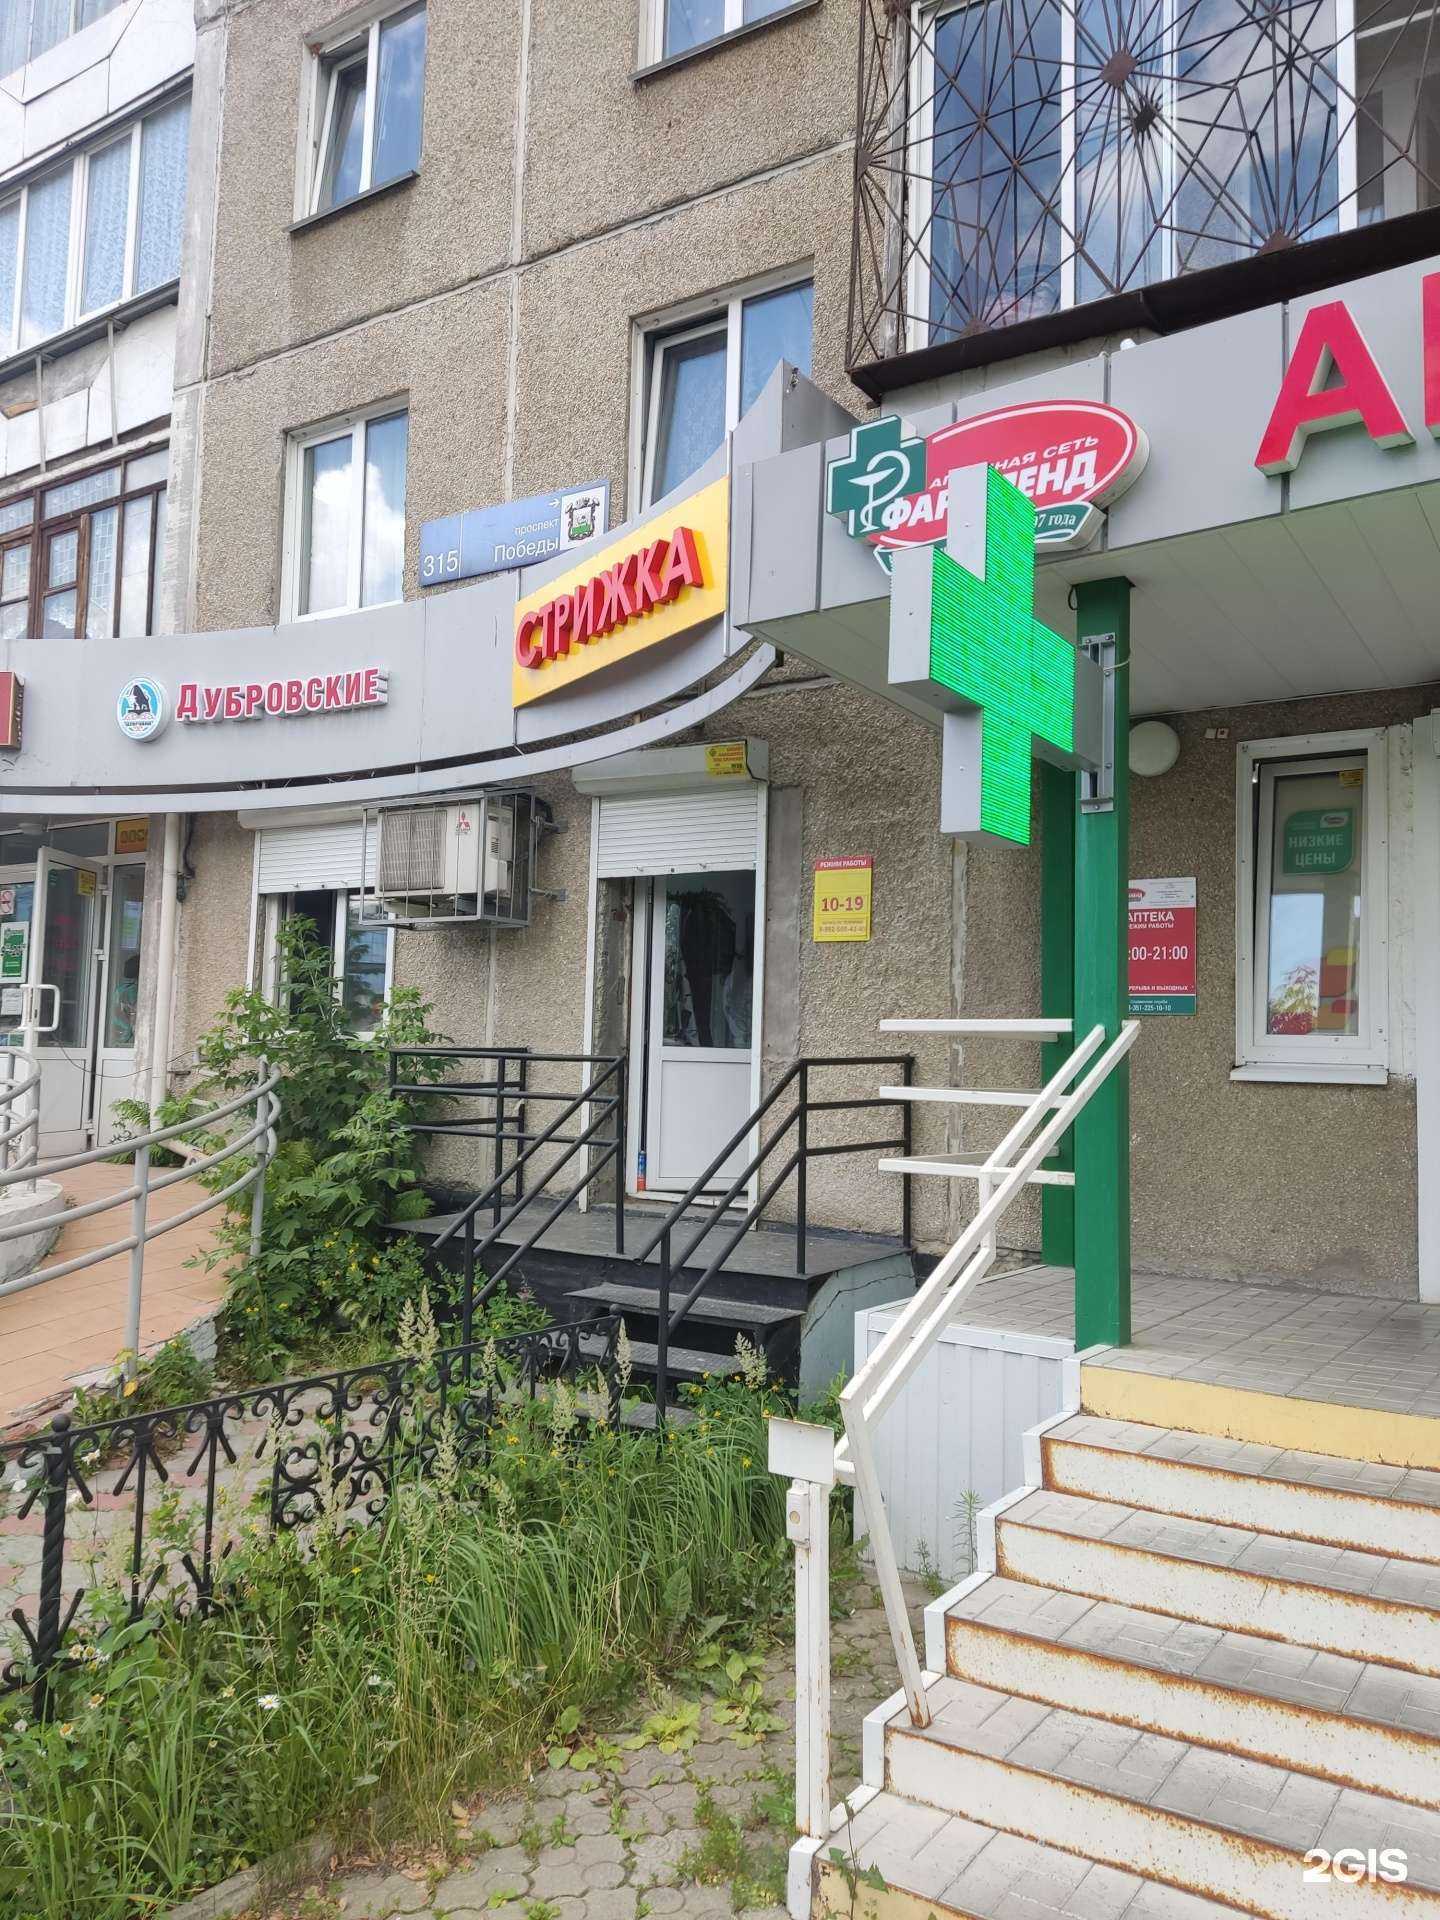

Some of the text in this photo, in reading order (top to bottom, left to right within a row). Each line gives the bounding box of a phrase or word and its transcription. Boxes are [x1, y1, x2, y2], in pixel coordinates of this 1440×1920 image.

[1254, 271, 1440, 476] А
[928, 436, 1099, 490] АПНАЯ СЕТЬ
[881, 450, 1098, 531] ФАРЕНД
[514, 518, 560, 537] проспект
[1048, 513, 1077, 527] года
[494, 537, 560, 562] Победы
[423, 550, 459, 577] 315
[516, 526, 704, 669] СТРИЖКА
[176, 667, 389, 723] ДУБРОВСКИЕ
[1289, 833, 1345, 848] НИЗКИЕ
[842, 859, 867, 868] РАБОТЫ
[1295, 851, 1336, 867] ЦЕНЫ
[821, 896, 864, 912] 10-19
[1128, 946, 1188, 961] :00-21:00
